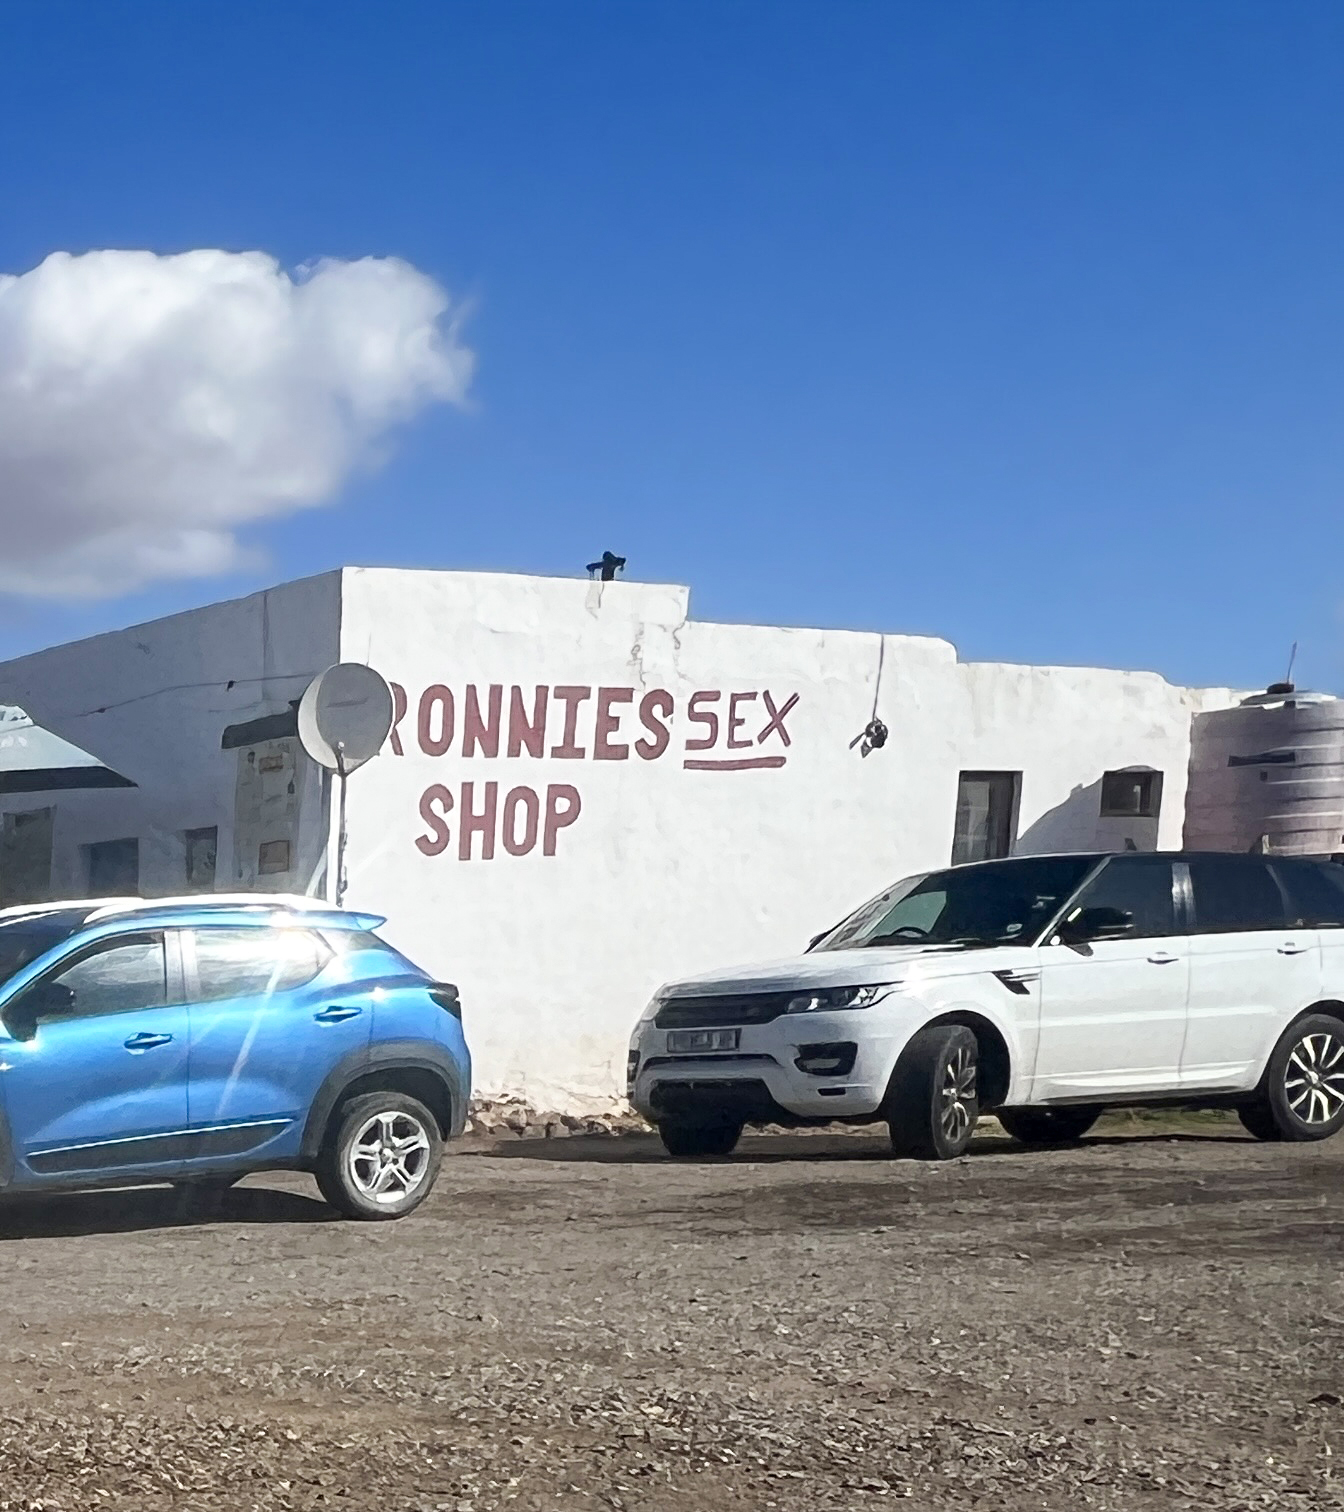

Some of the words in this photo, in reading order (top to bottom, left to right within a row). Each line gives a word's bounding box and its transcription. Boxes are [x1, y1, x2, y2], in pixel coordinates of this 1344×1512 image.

[387, 681, 674, 761] RONNIES
[683, 688, 801, 751] SEX
[414, 781, 582, 861] SHOP
